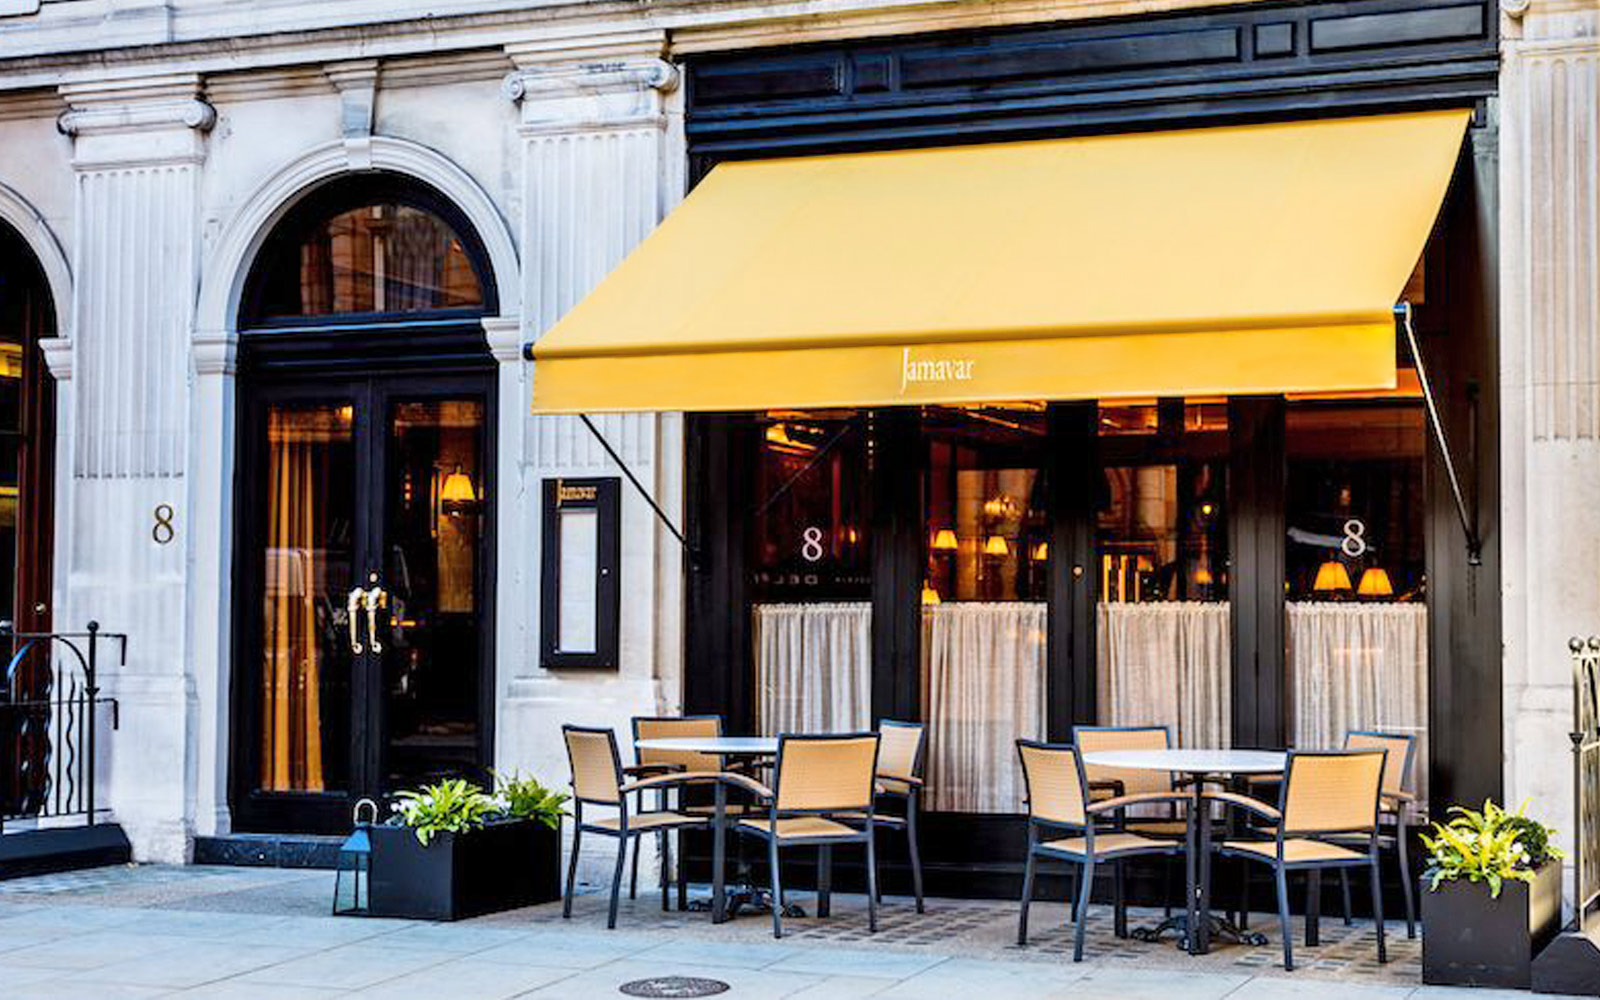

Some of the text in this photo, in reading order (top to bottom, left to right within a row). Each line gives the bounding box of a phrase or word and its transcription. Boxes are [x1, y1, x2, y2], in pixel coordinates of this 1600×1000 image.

[900, 347, 975, 395] Jamavar
[152, 504, 174, 544] 8
[1342, 519, 1366, 557] 8
[802, 526, 823, 562] 8
